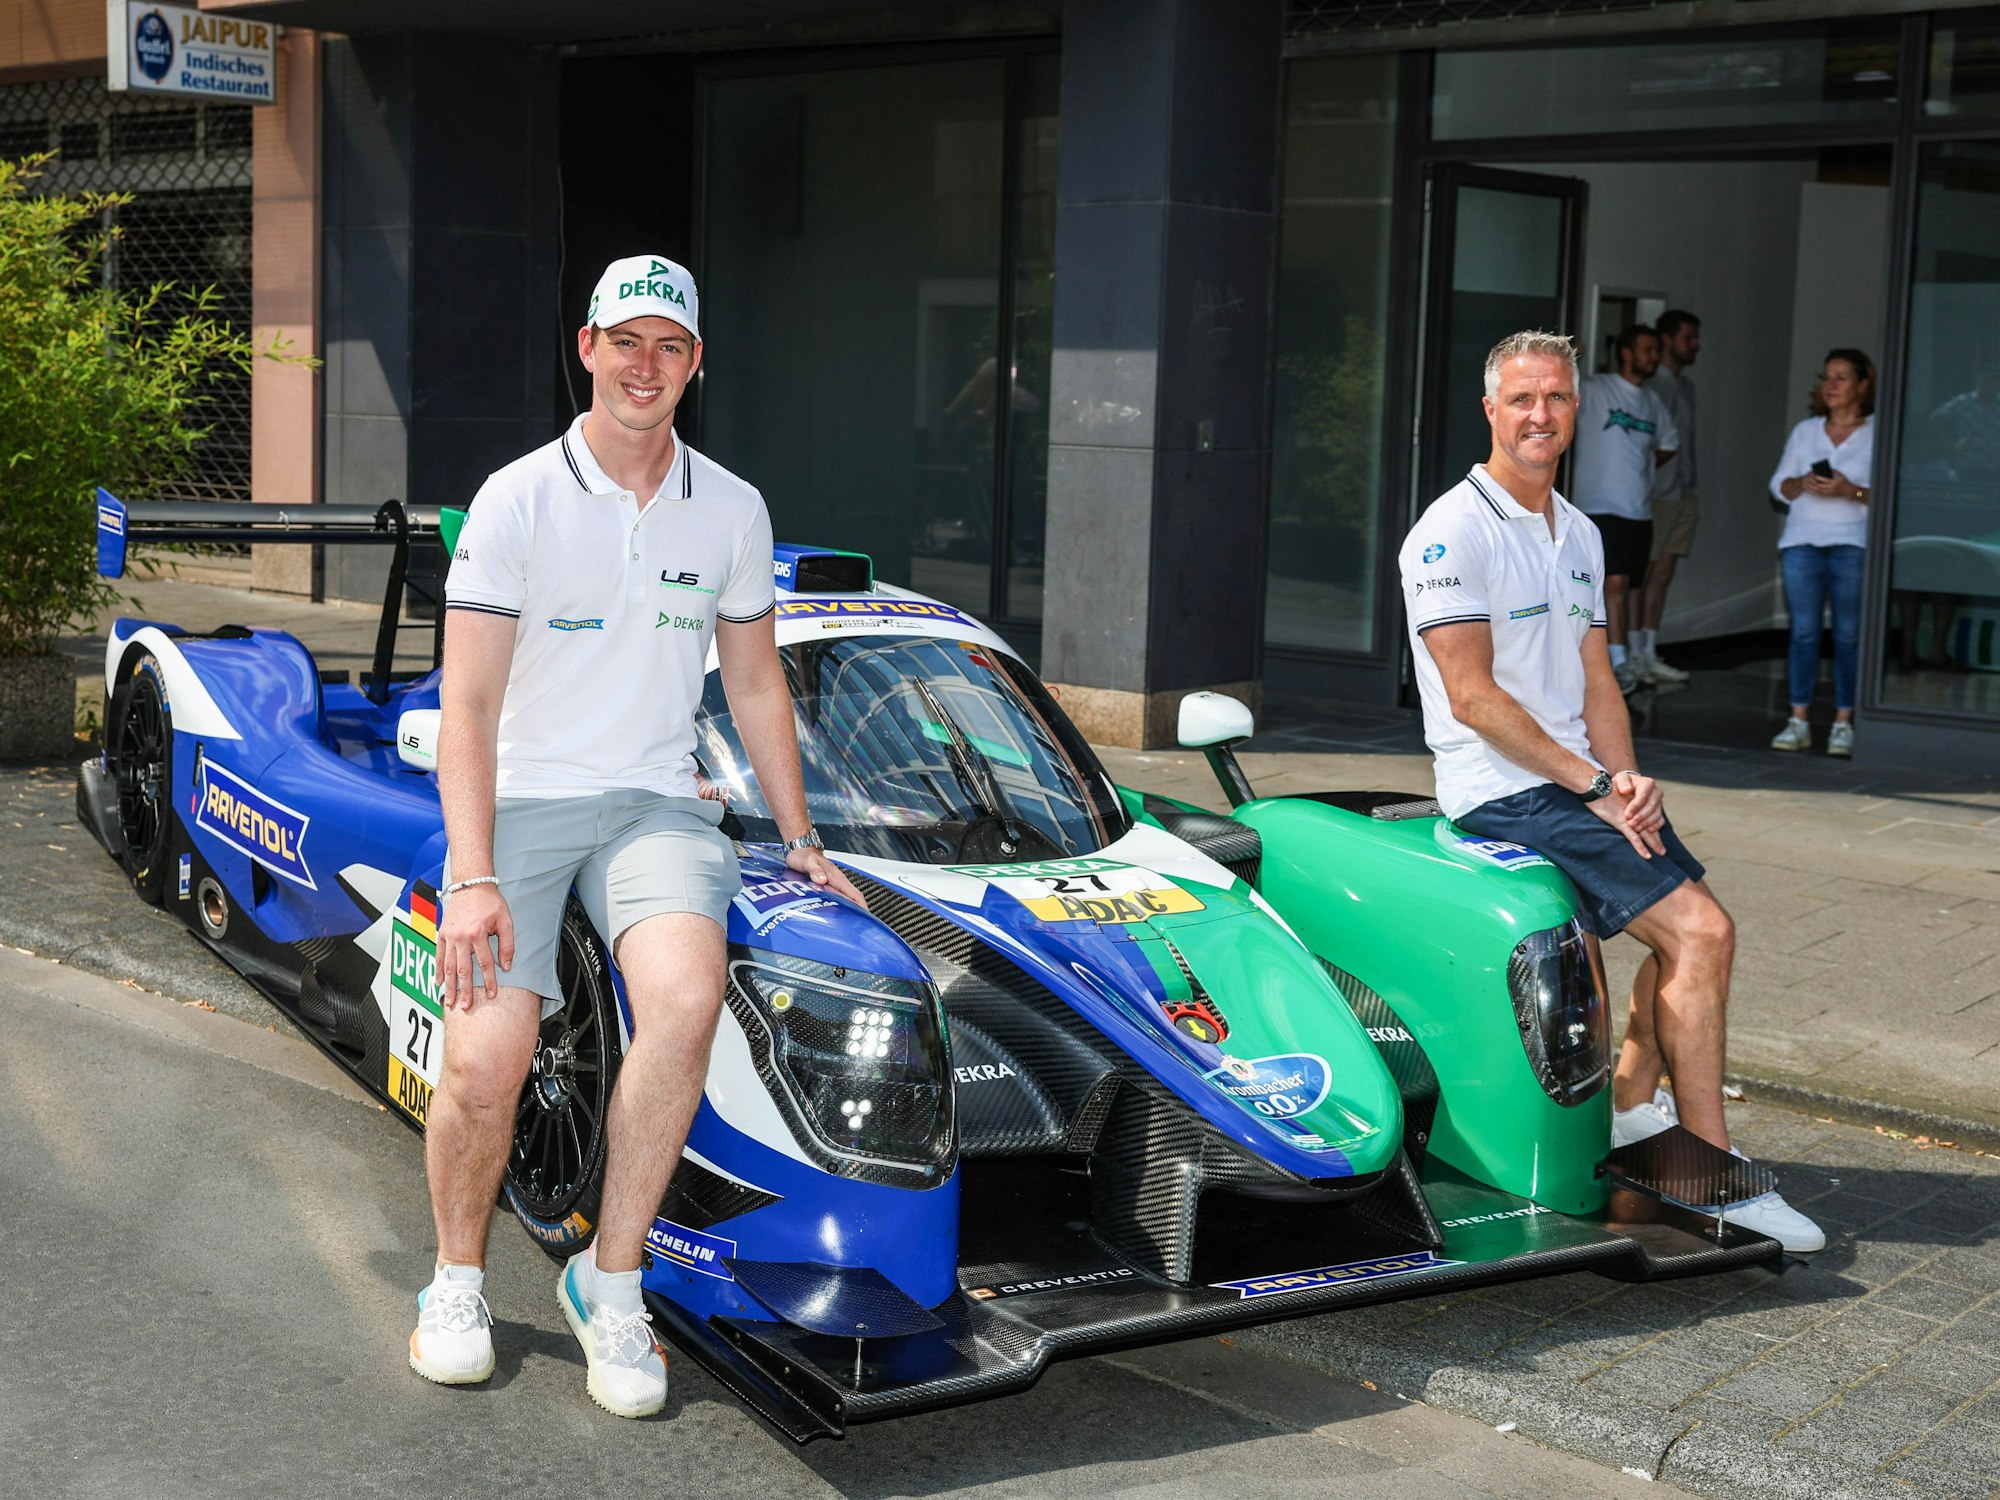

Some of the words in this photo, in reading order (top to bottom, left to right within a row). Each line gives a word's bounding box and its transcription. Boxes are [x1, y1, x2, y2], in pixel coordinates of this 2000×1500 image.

[181, 14, 269, 50] JAIPUR
[186, 52, 264, 76] Indisches
[181, 71, 269, 97] Restaurant
[619, 280, 686, 310] DEKRA
[455, 548, 469, 561] KRA
[660, 569, 700, 586] US
[1426, 577, 1461, 590] DEKRA
[552, 620, 600, 630] RAVENOL
[402, 732, 420, 749] US
[207, 783, 295, 862] RAVENOL
[958, 858, 1115, 878] DEKRA
[1035, 874, 1111, 893] 27
[1058, 892, 1168, 923] ADAC
[406, 1008, 432, 1072] 27
[1365, 1026, 1414, 1042] EKRA
[1215, 1073, 1305, 1096] Krombacher
[1254, 1094, 1306, 1116] 0,0%
[1441, 1206, 1552, 1227] CREVENTIC
[647, 1227, 716, 1262] ICHELIN
[1000, 1268, 1133, 1293] CREVENTIC
[1246, 1258, 1434, 1291] RAVENOL
